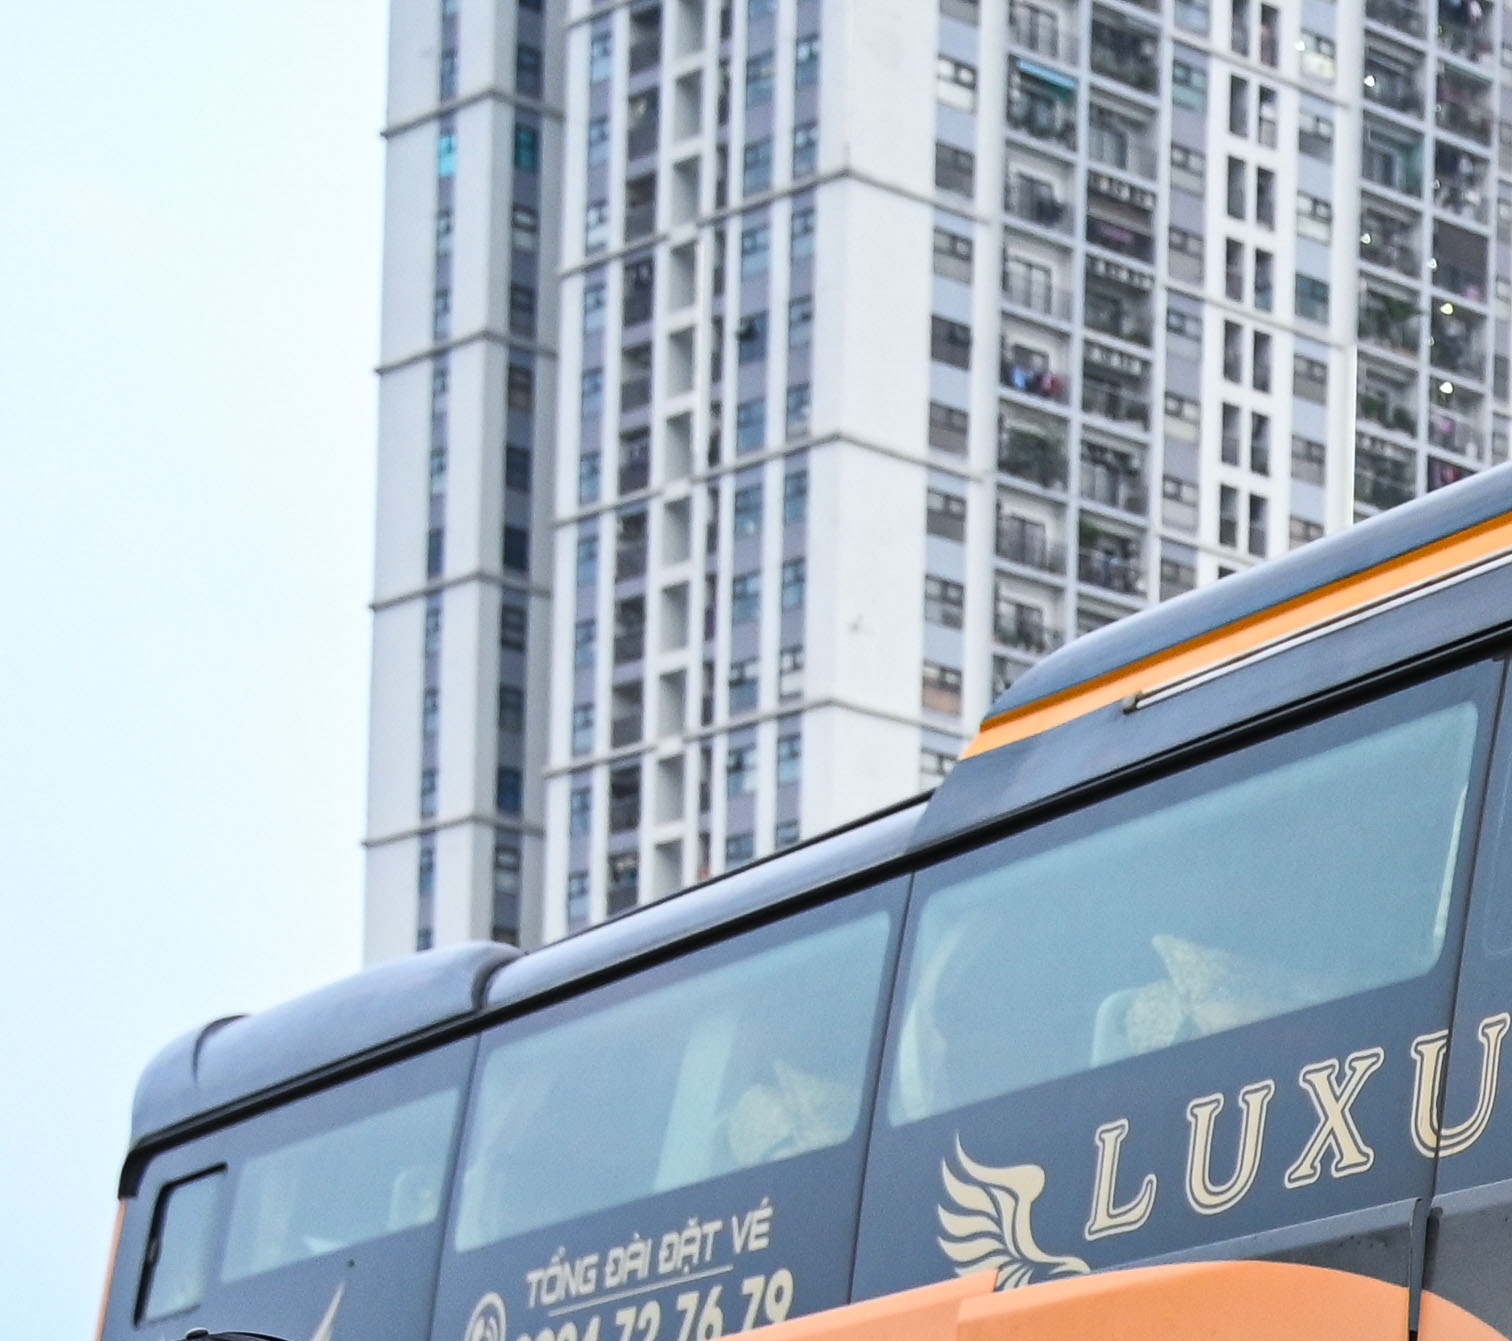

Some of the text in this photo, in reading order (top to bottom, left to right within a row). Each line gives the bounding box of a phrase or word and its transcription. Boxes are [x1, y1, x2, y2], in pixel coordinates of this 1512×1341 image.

[526, 1197, 774, 1308] TỔNG ĐÀI ĐẶT VÉ
